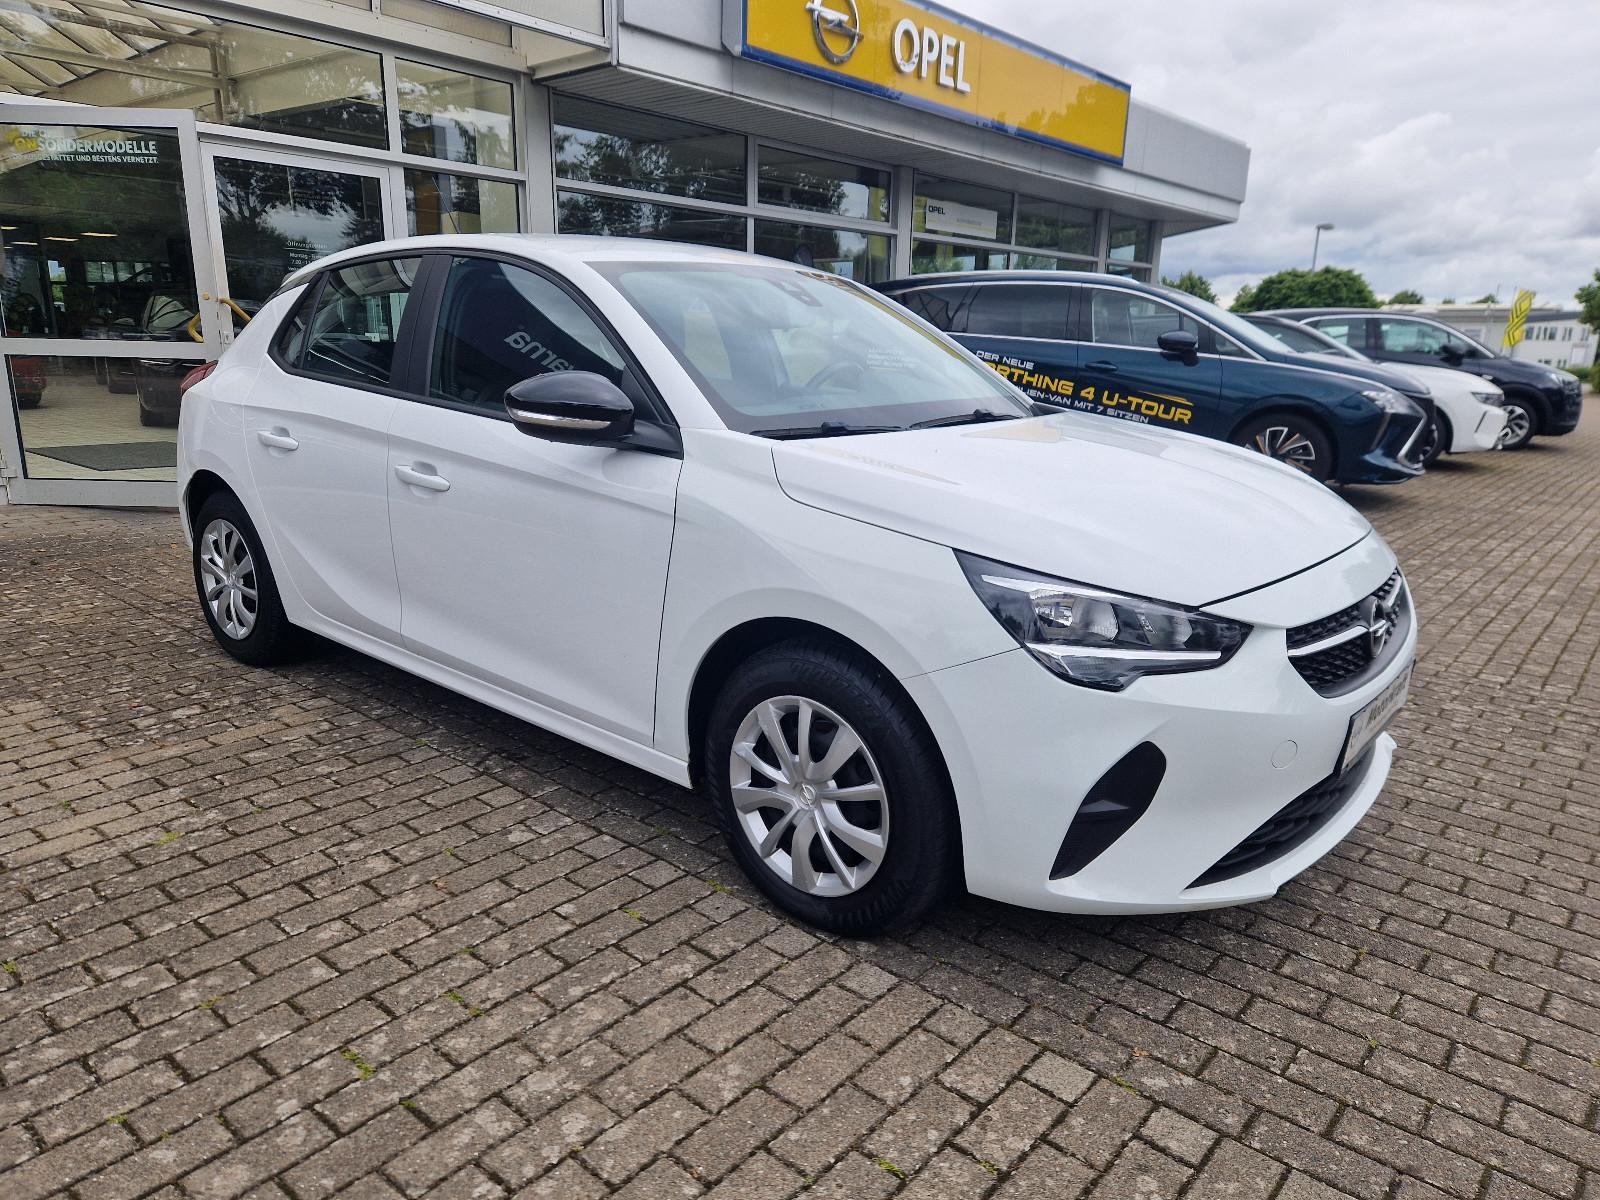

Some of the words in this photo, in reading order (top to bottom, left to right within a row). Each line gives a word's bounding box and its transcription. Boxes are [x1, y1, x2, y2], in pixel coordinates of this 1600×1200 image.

[892, 17, 971, 94] OPEL
[76, 154, 91, 163] UND
[92, 155, 122, 164] BESTENS
[928, 205, 945, 215] OPEL
[976, 350, 1000, 362] DER
[1002, 356, 1035, 370] NEUE
[1074, 400, 1094, 411] MIT
[1096, 405, 1104, 413] 7
[1106, 408, 1149, 424] SITZEN
[1080, 386, 1095, 400] 4
[1102, 390, 1192, 425] U-TOUR
